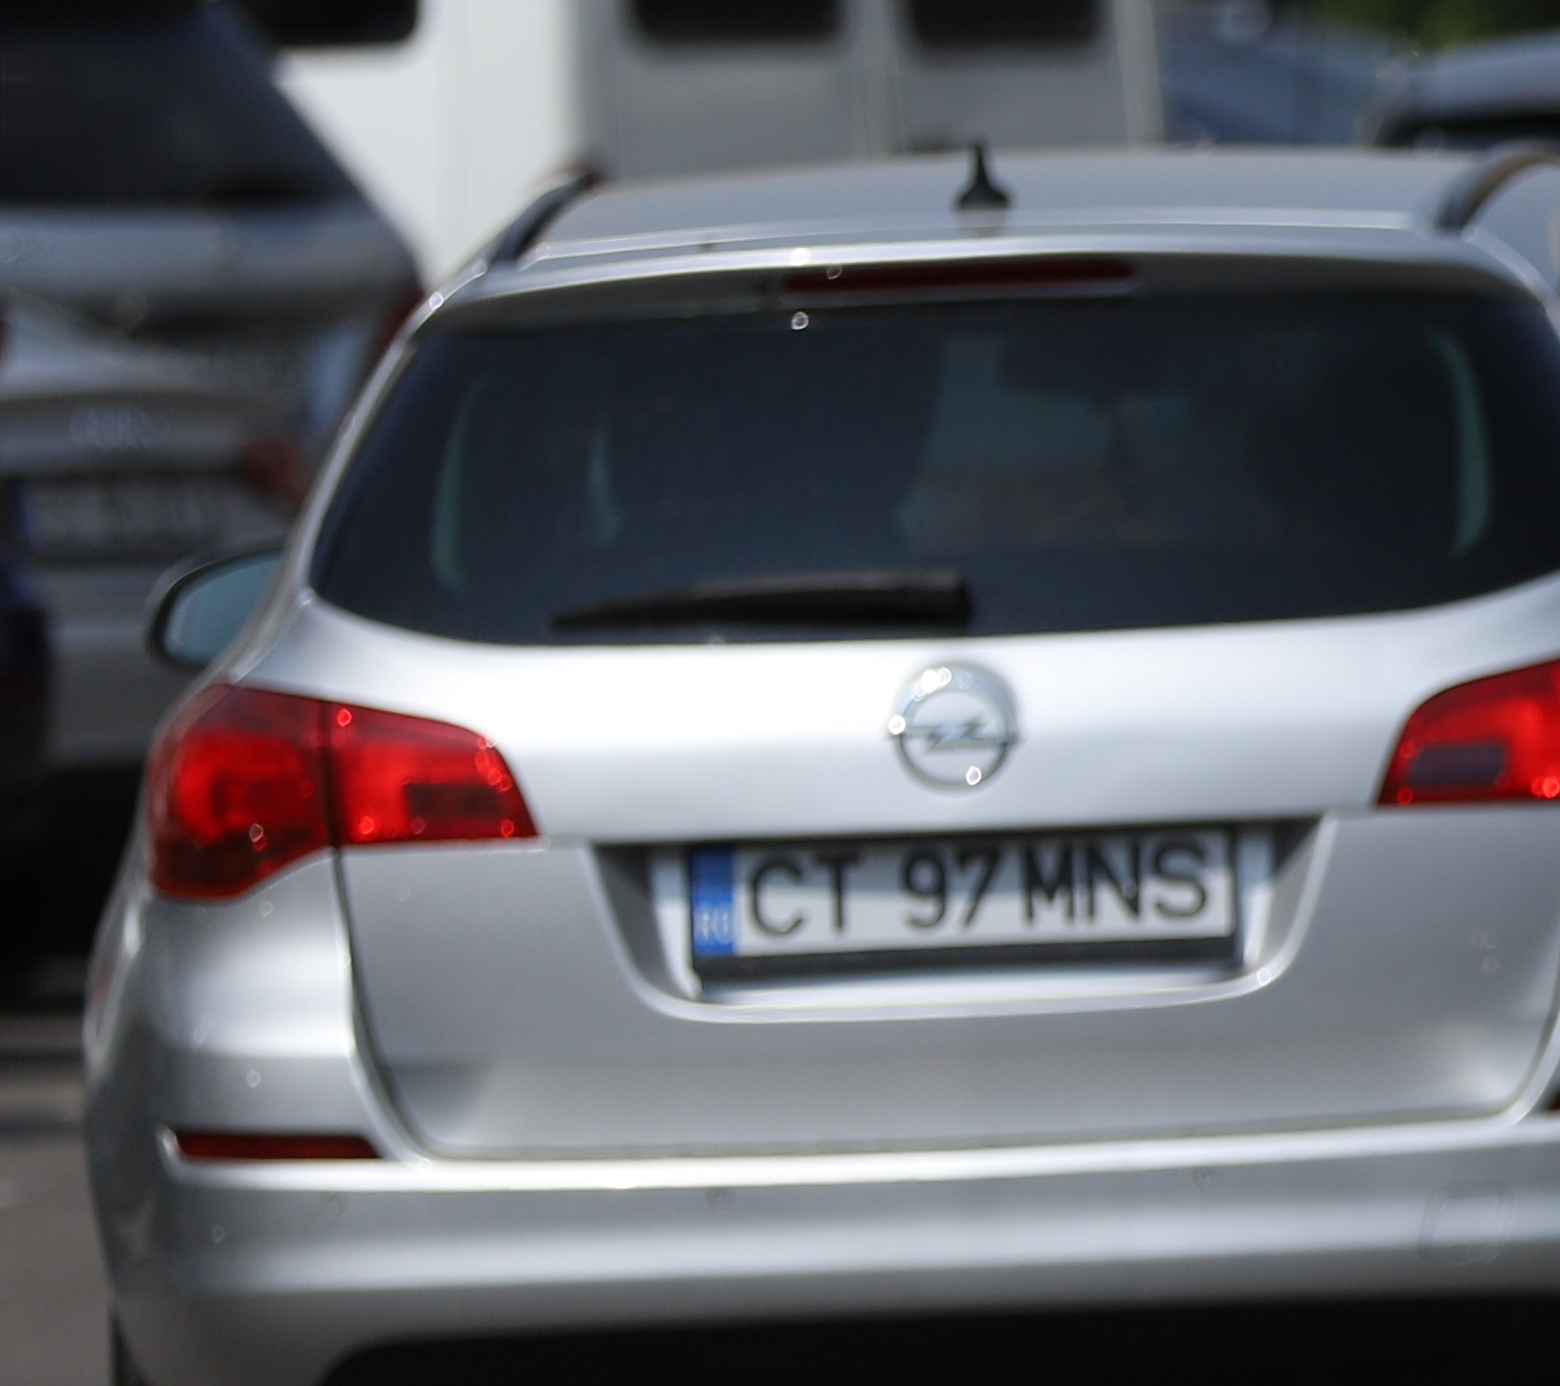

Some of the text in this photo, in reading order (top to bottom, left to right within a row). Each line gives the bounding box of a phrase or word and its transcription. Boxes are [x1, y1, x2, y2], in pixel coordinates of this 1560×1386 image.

[749, 836, 1209, 938] CT 97 MNS
